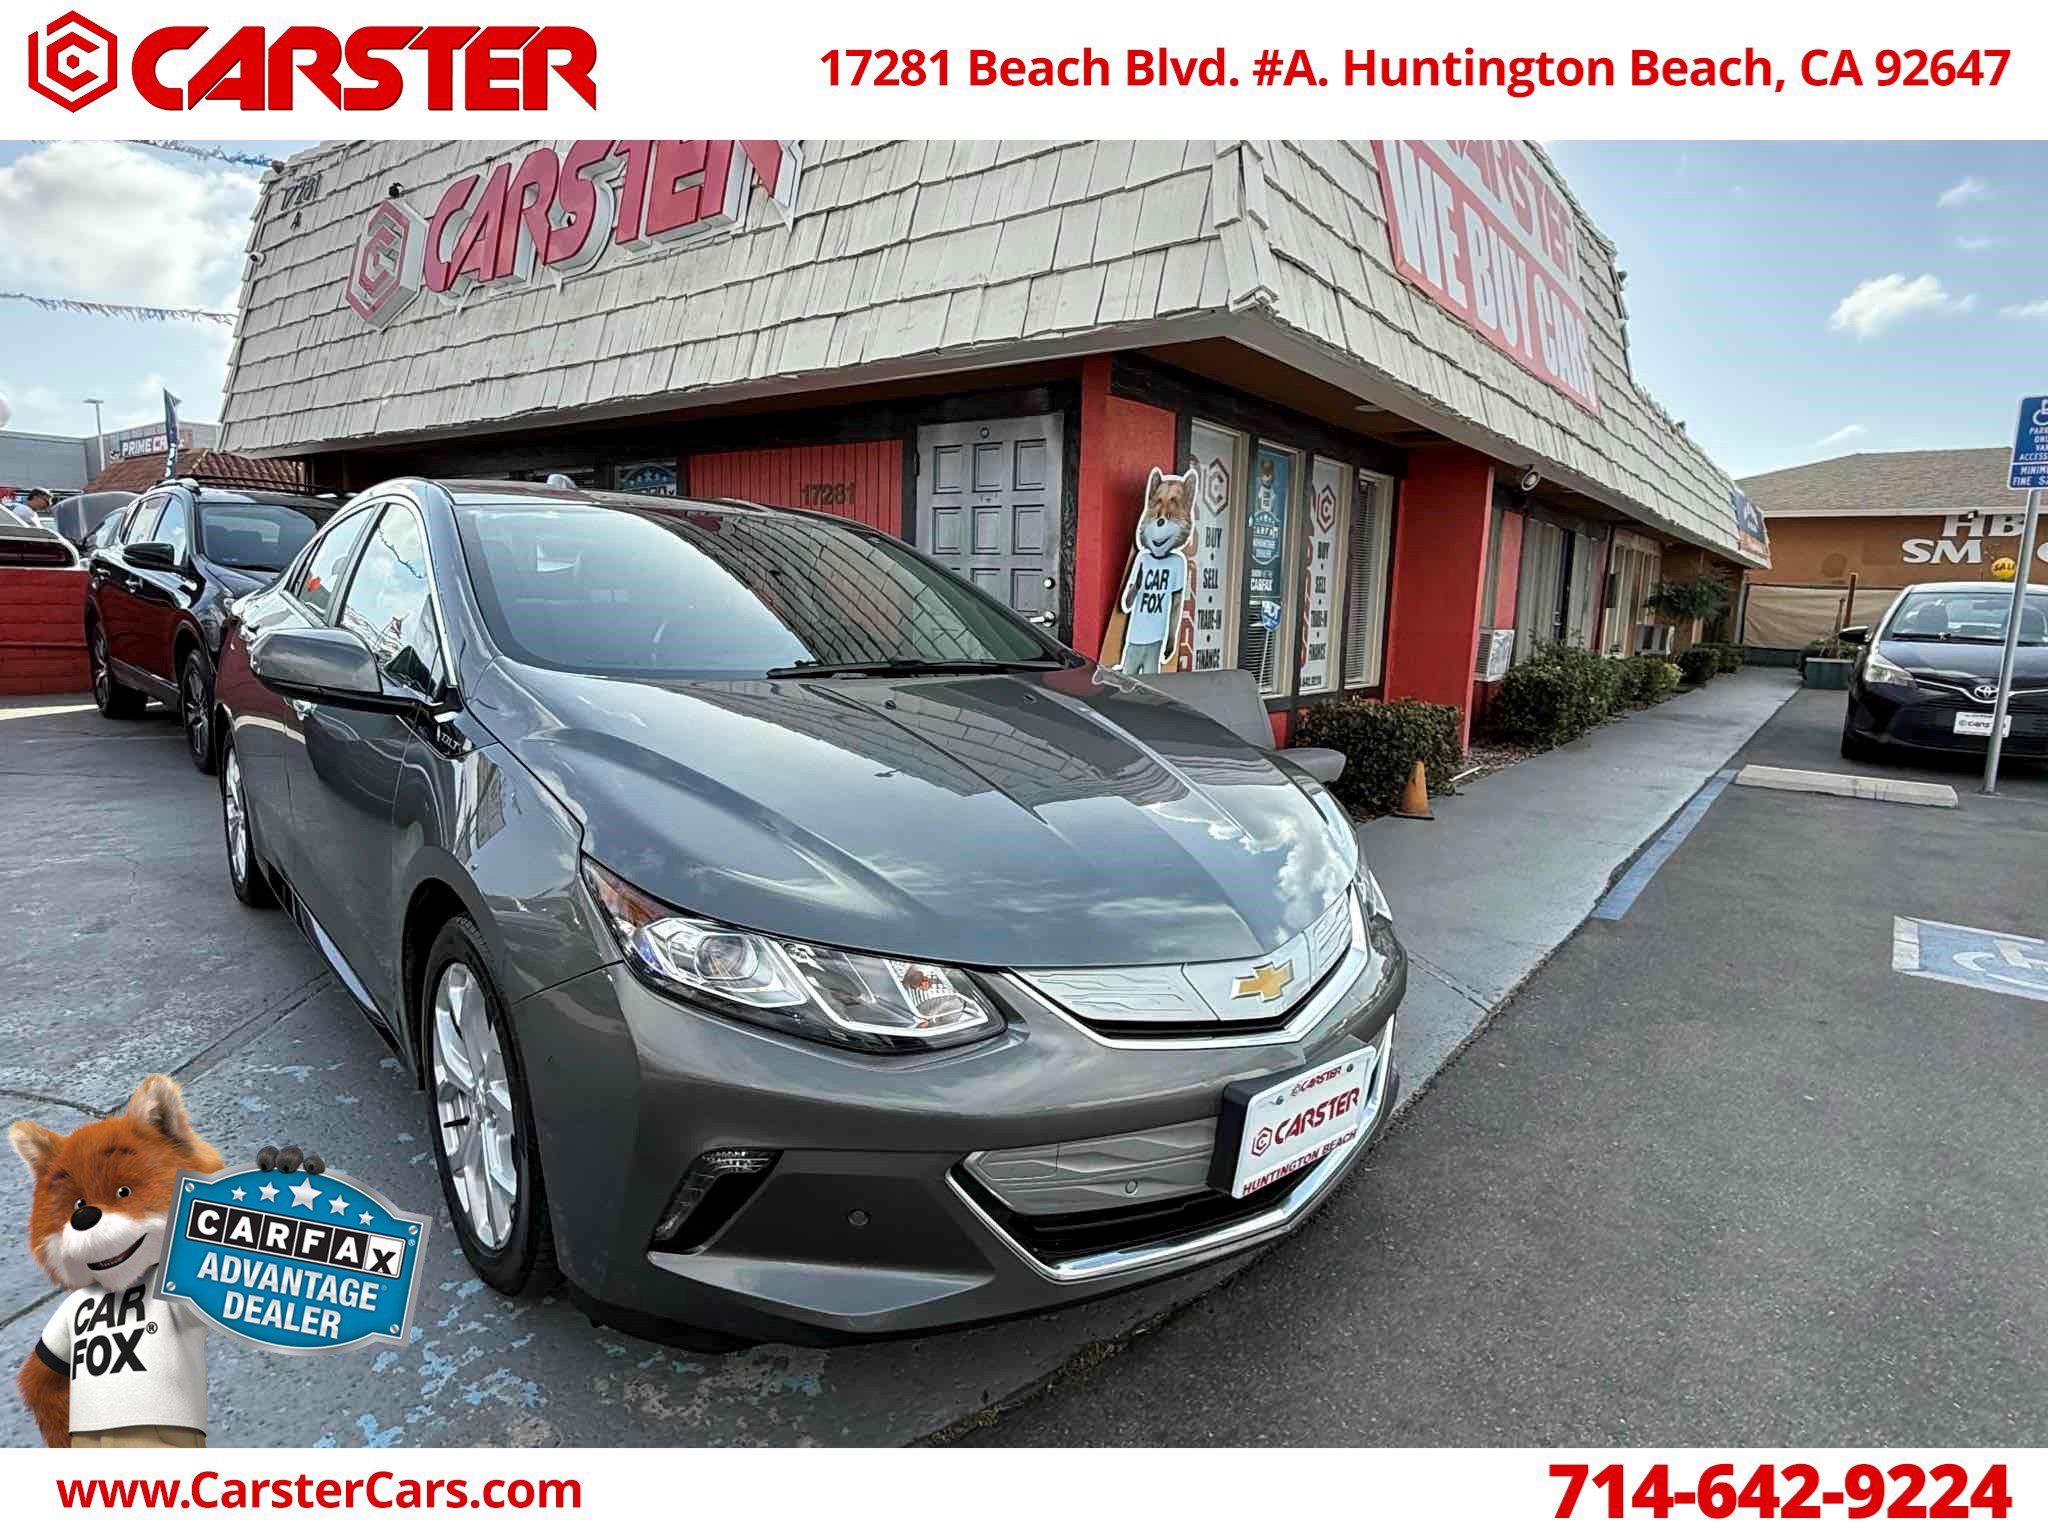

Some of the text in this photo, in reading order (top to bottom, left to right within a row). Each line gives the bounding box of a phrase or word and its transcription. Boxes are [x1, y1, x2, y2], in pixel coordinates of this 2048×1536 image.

[1383, 140, 1468, 309] WE
[1463, 201, 1533, 358] BUY
[1206, 527, 1222, 548] BUY
[1144, 568, 1170, 591] CAR
[1203, 567, 1218, 589] SELL
[1139, 592, 1165, 614] FOX
[1275, 1087, 1360, 1144] CARSTER
[1243, 1128, 1357, 1195] HUNTINGTON BEACH
